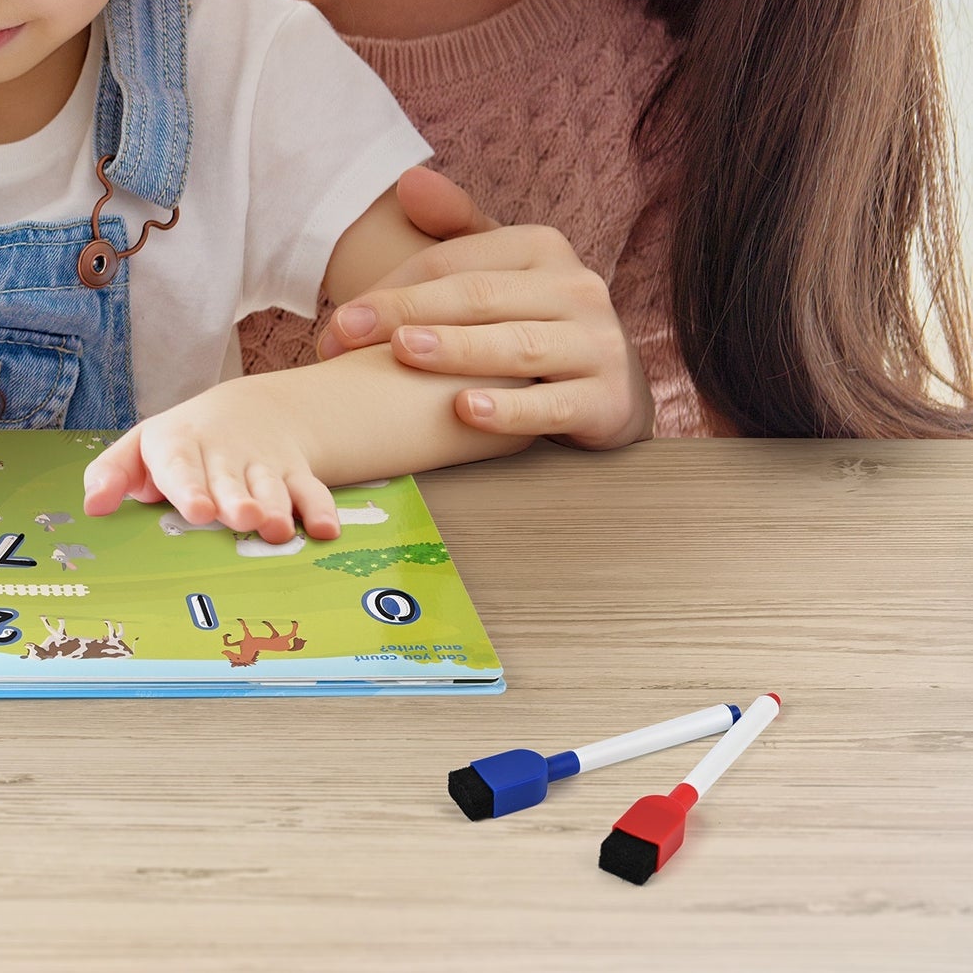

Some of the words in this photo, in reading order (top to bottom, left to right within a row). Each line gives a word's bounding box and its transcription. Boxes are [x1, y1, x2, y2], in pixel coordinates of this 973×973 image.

[360, 586, 422, 626] 0
[380, 644, 428, 653] write?
[433, 644, 463, 653] and
[354, 654, 398, 662] count
[403, 652, 432, 662] you
[437, 653, 468, 662] Can
